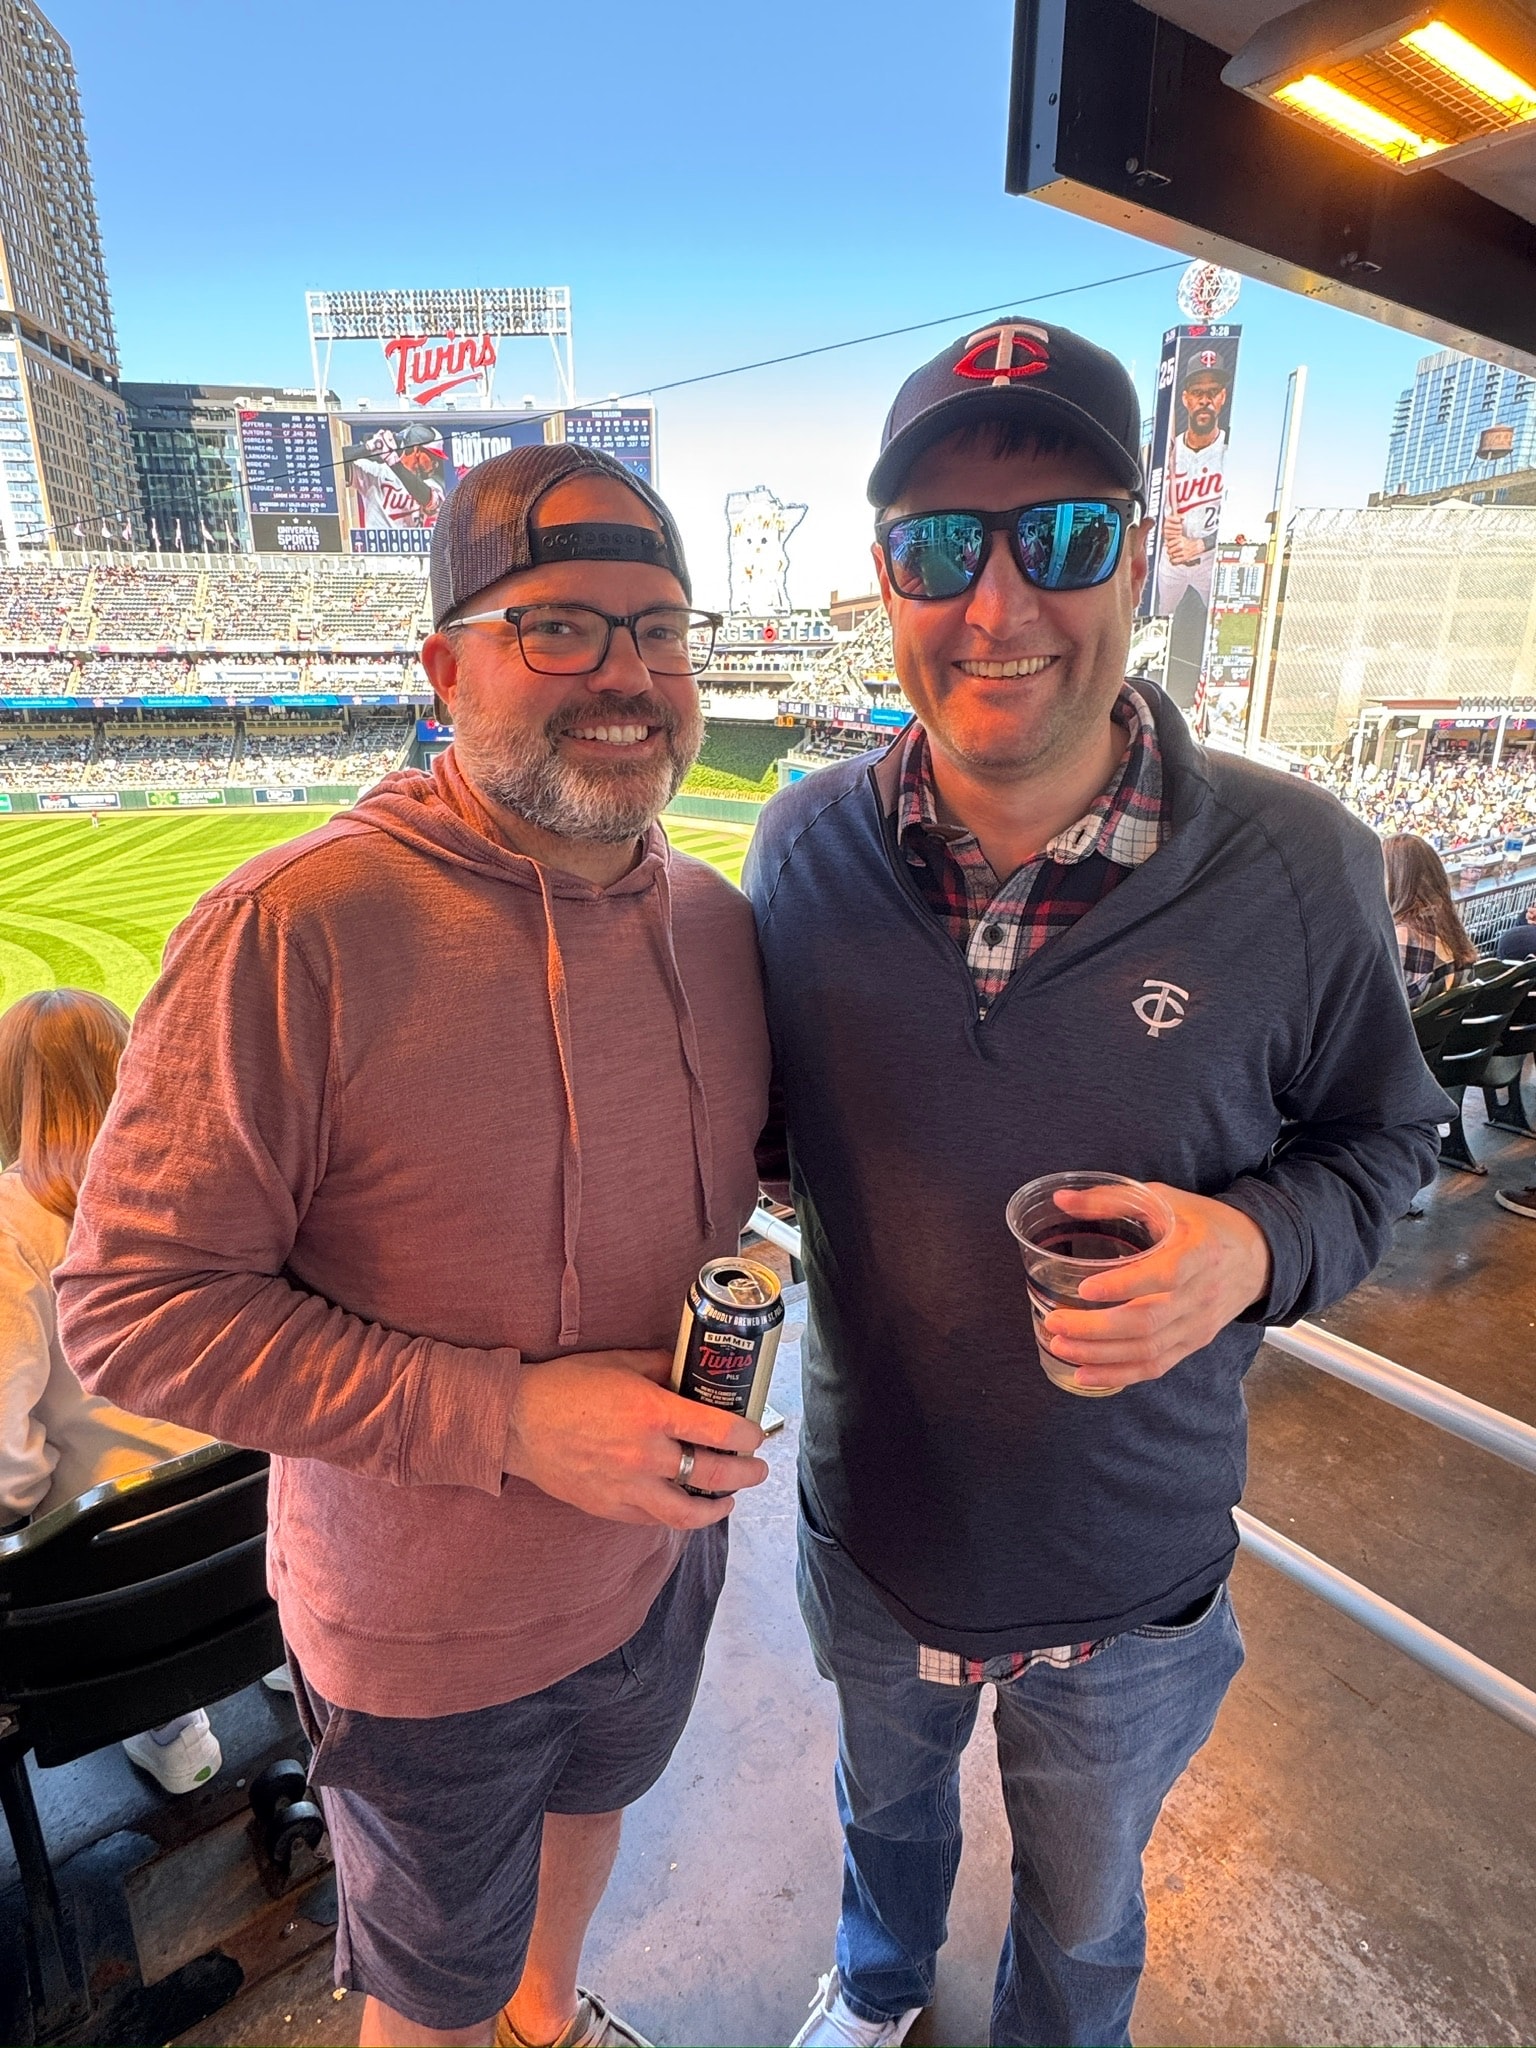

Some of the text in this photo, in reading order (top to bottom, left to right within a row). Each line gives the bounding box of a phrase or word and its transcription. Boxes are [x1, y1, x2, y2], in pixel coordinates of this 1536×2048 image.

[385, 329, 496, 400] Twins
[1158, 358, 1175, 389] 25
[277, 526, 318, 534] UNIVERSAL
[278, 534, 319, 546] SPORTS
[779, 626, 834, 642] FIELD
[1459, 696, 1536, 712] WINNEB
[702, 1305, 733, 1324] PROUDLY
[734, 1316, 760, 1326] BREWED
[761, 1316, 767, 1325] IN
[707, 1334, 752, 1348] SUMMIT
[699, 1346, 752, 1370] Twins
